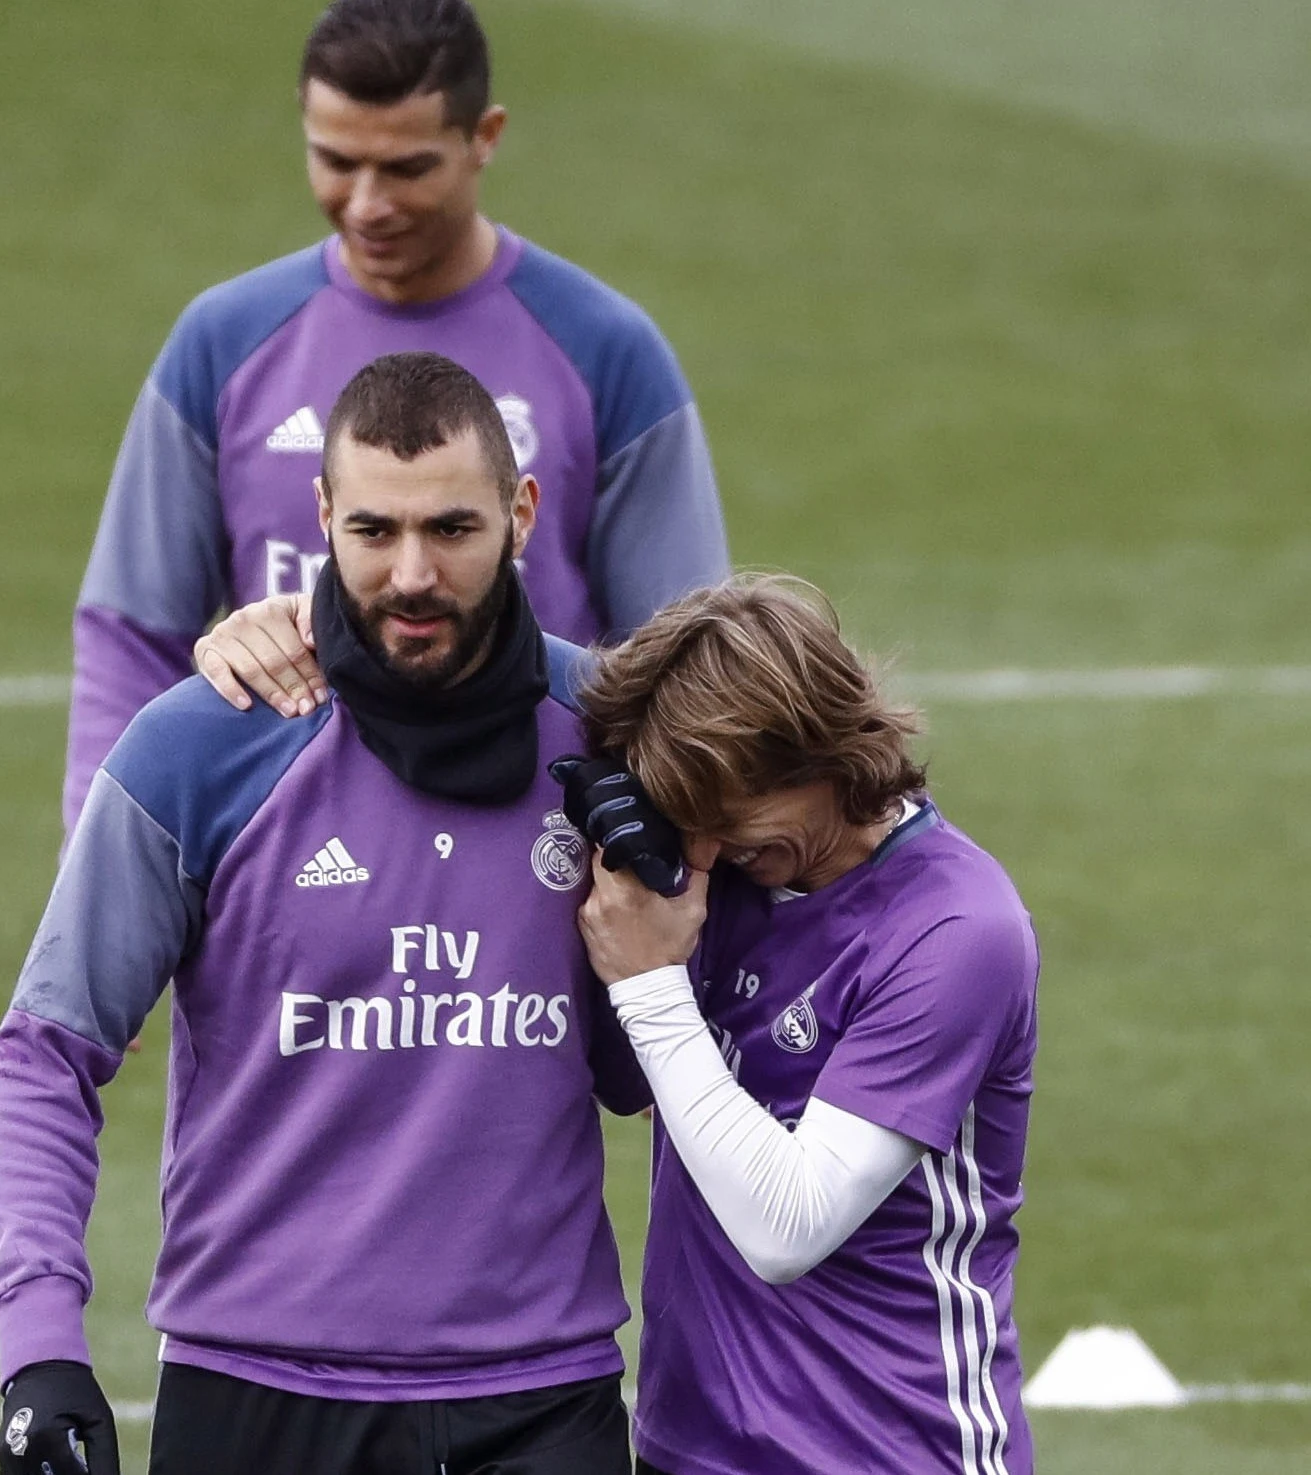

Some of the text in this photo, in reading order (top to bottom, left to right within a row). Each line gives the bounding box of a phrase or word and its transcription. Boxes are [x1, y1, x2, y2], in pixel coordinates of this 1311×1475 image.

[434, 833, 454, 859] 9
[295, 867, 370, 887] adidas
[390, 924, 480, 979] Fly
[735, 968, 760, 999] 19
[279, 979, 570, 1057] Emirates
